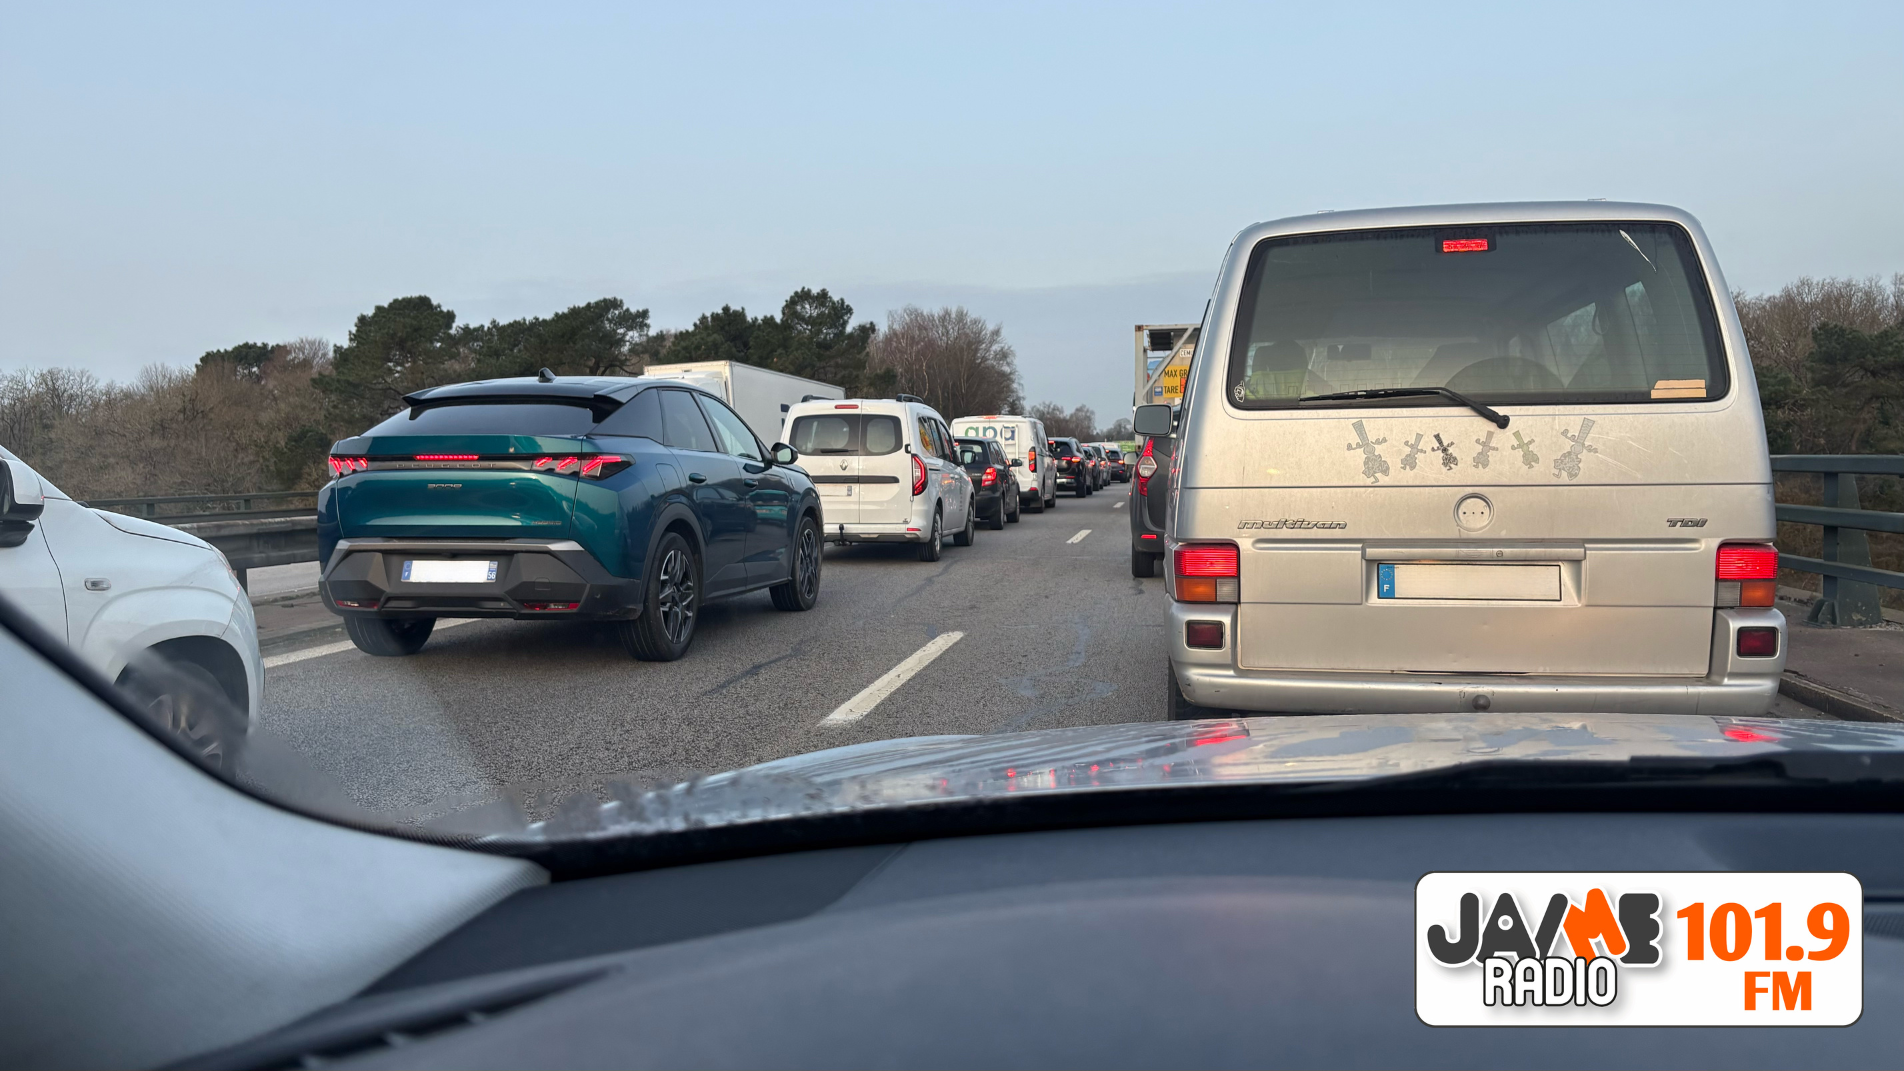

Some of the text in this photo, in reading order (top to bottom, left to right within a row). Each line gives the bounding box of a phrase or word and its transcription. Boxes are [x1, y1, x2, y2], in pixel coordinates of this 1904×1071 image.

[1164, 369, 1177, 378] MAX
[1164, 385, 1178, 394] TARE
[1237, 518, 1347, 529] multivan
[1667, 517, 1708, 528] TDI
[1383, 584, 1390, 593] F
